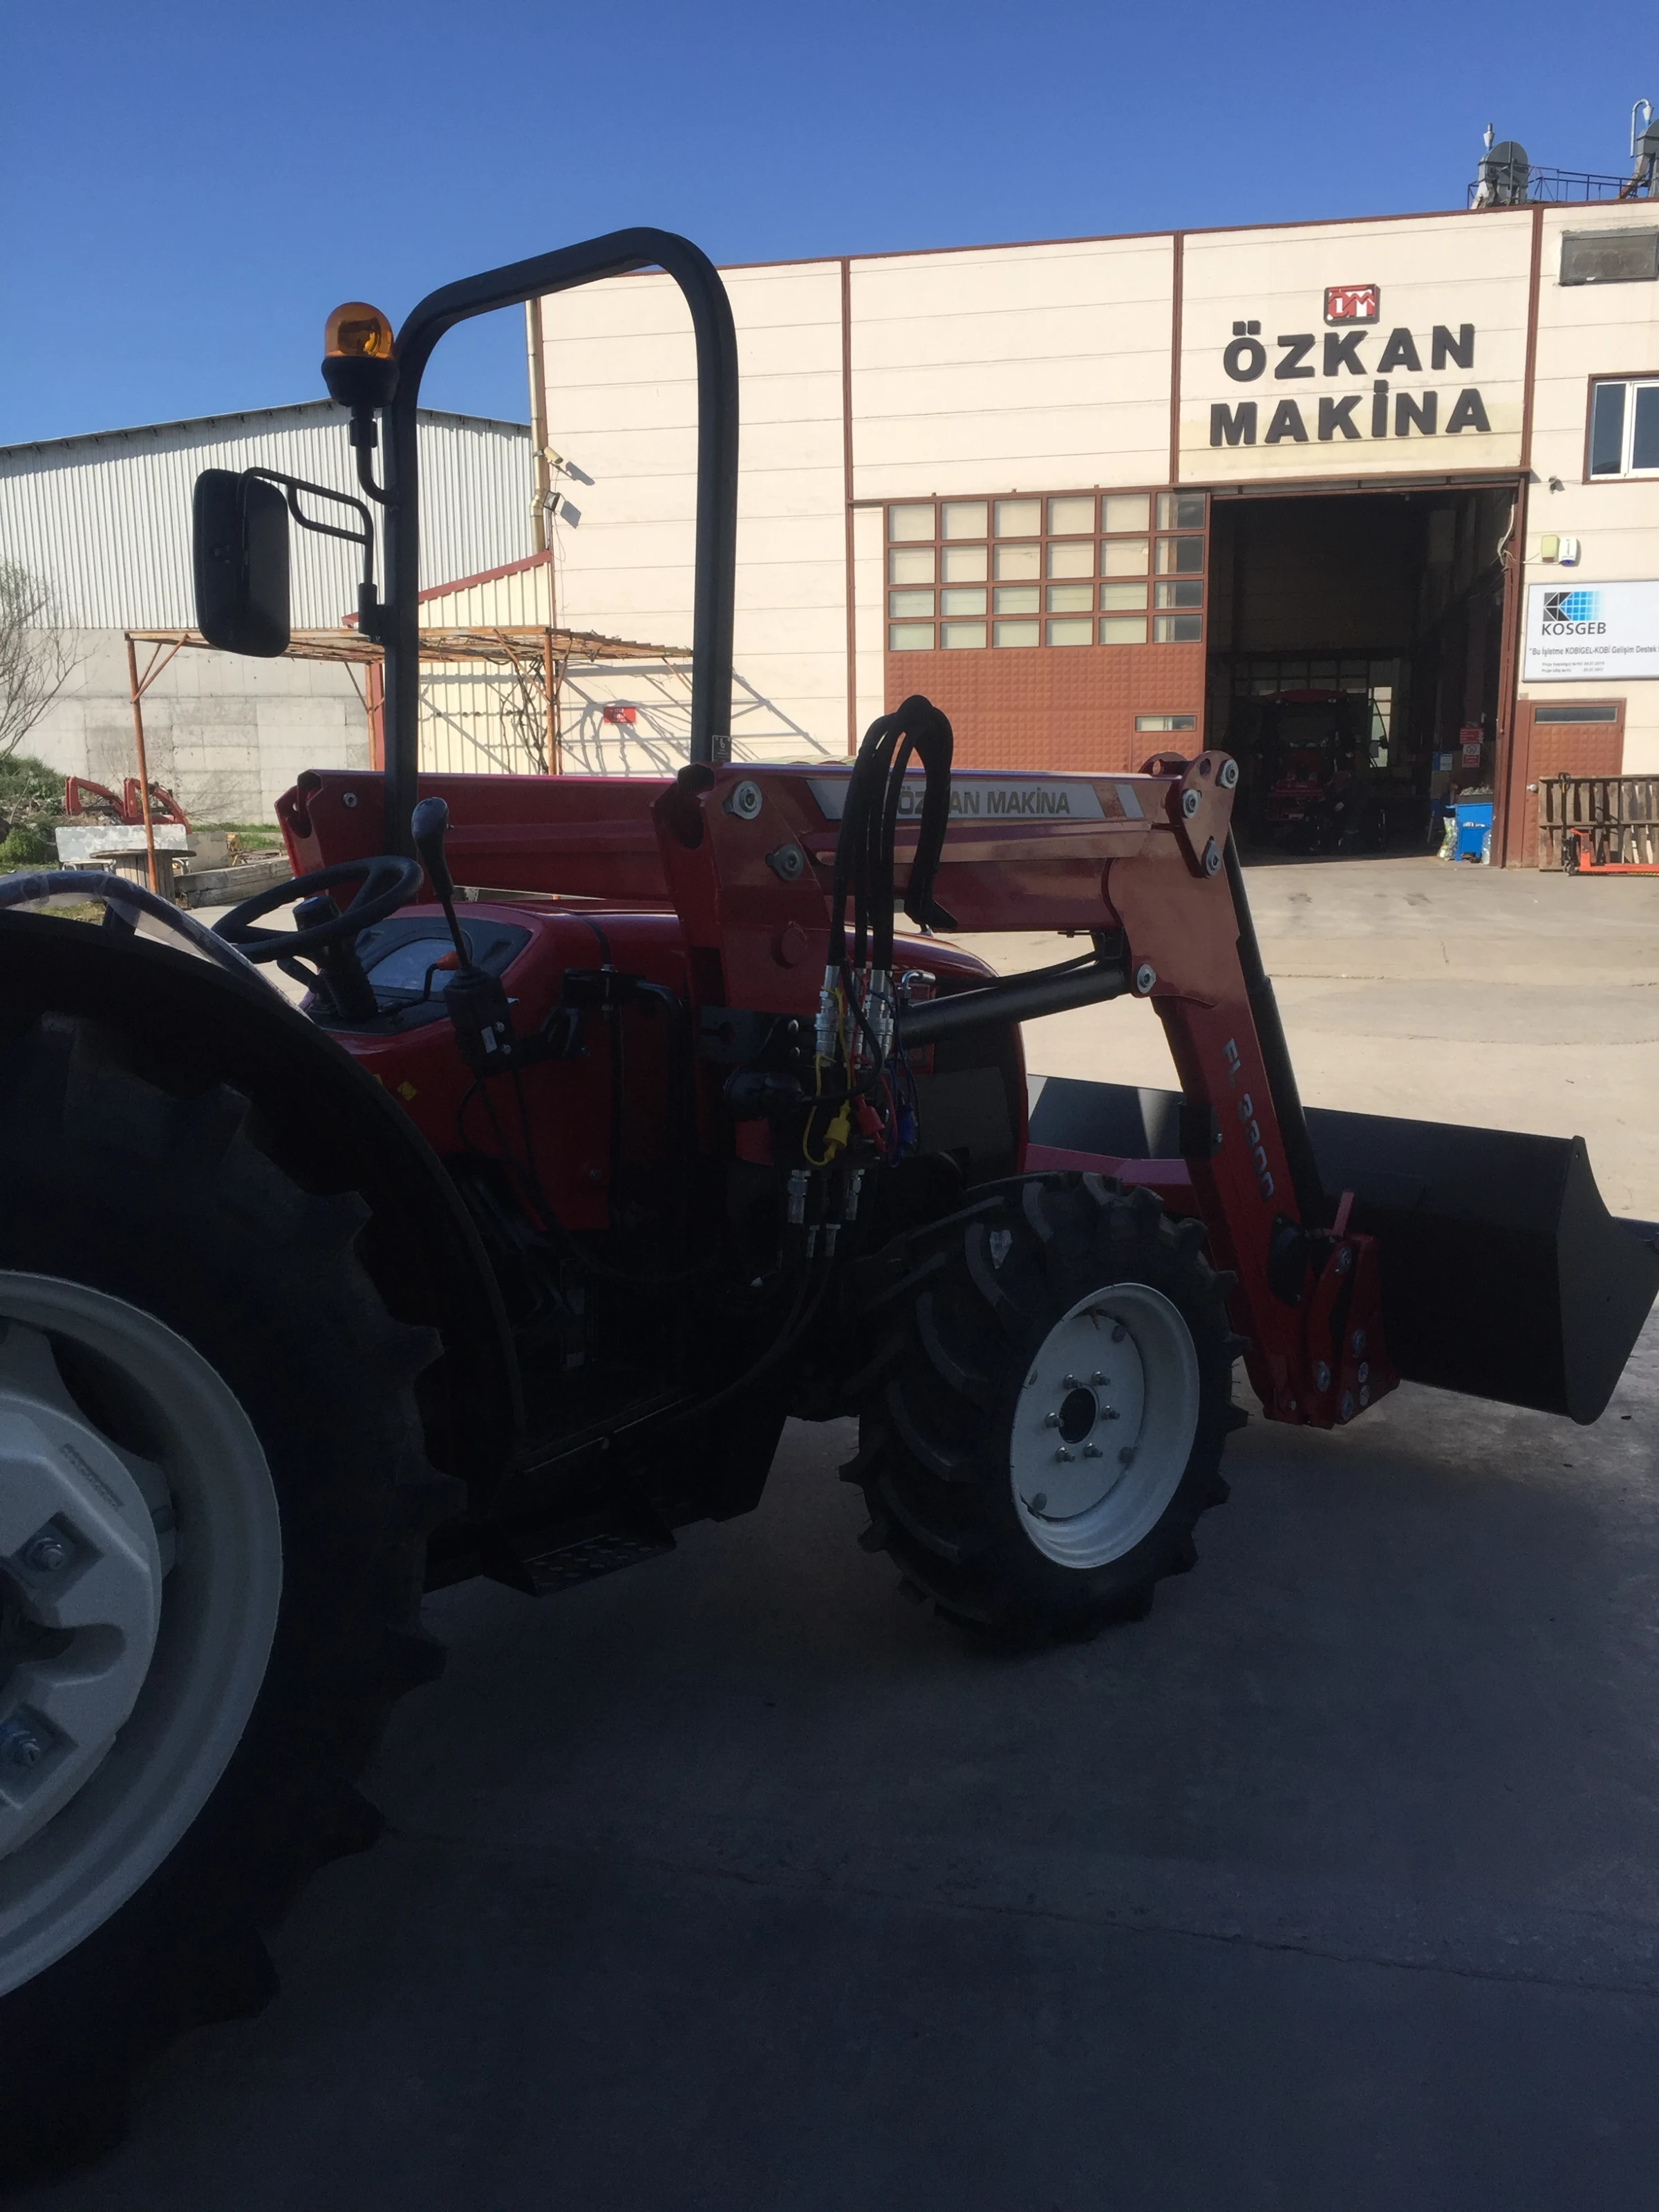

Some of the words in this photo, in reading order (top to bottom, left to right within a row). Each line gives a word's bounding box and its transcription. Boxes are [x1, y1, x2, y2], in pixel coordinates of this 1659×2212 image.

[1222, 319, 1476, 382] ÖZKAN
[1210, 379, 1492, 447] MAKİNA
[1541, 621, 1606, 635] KOSGEB
[1611, 646, 1635, 655] Gelişim
[1635, 645, 1657, 653] Destek
[898, 785, 980, 814] ÖZAN
[986, 787, 1071, 814] MAKİNA
